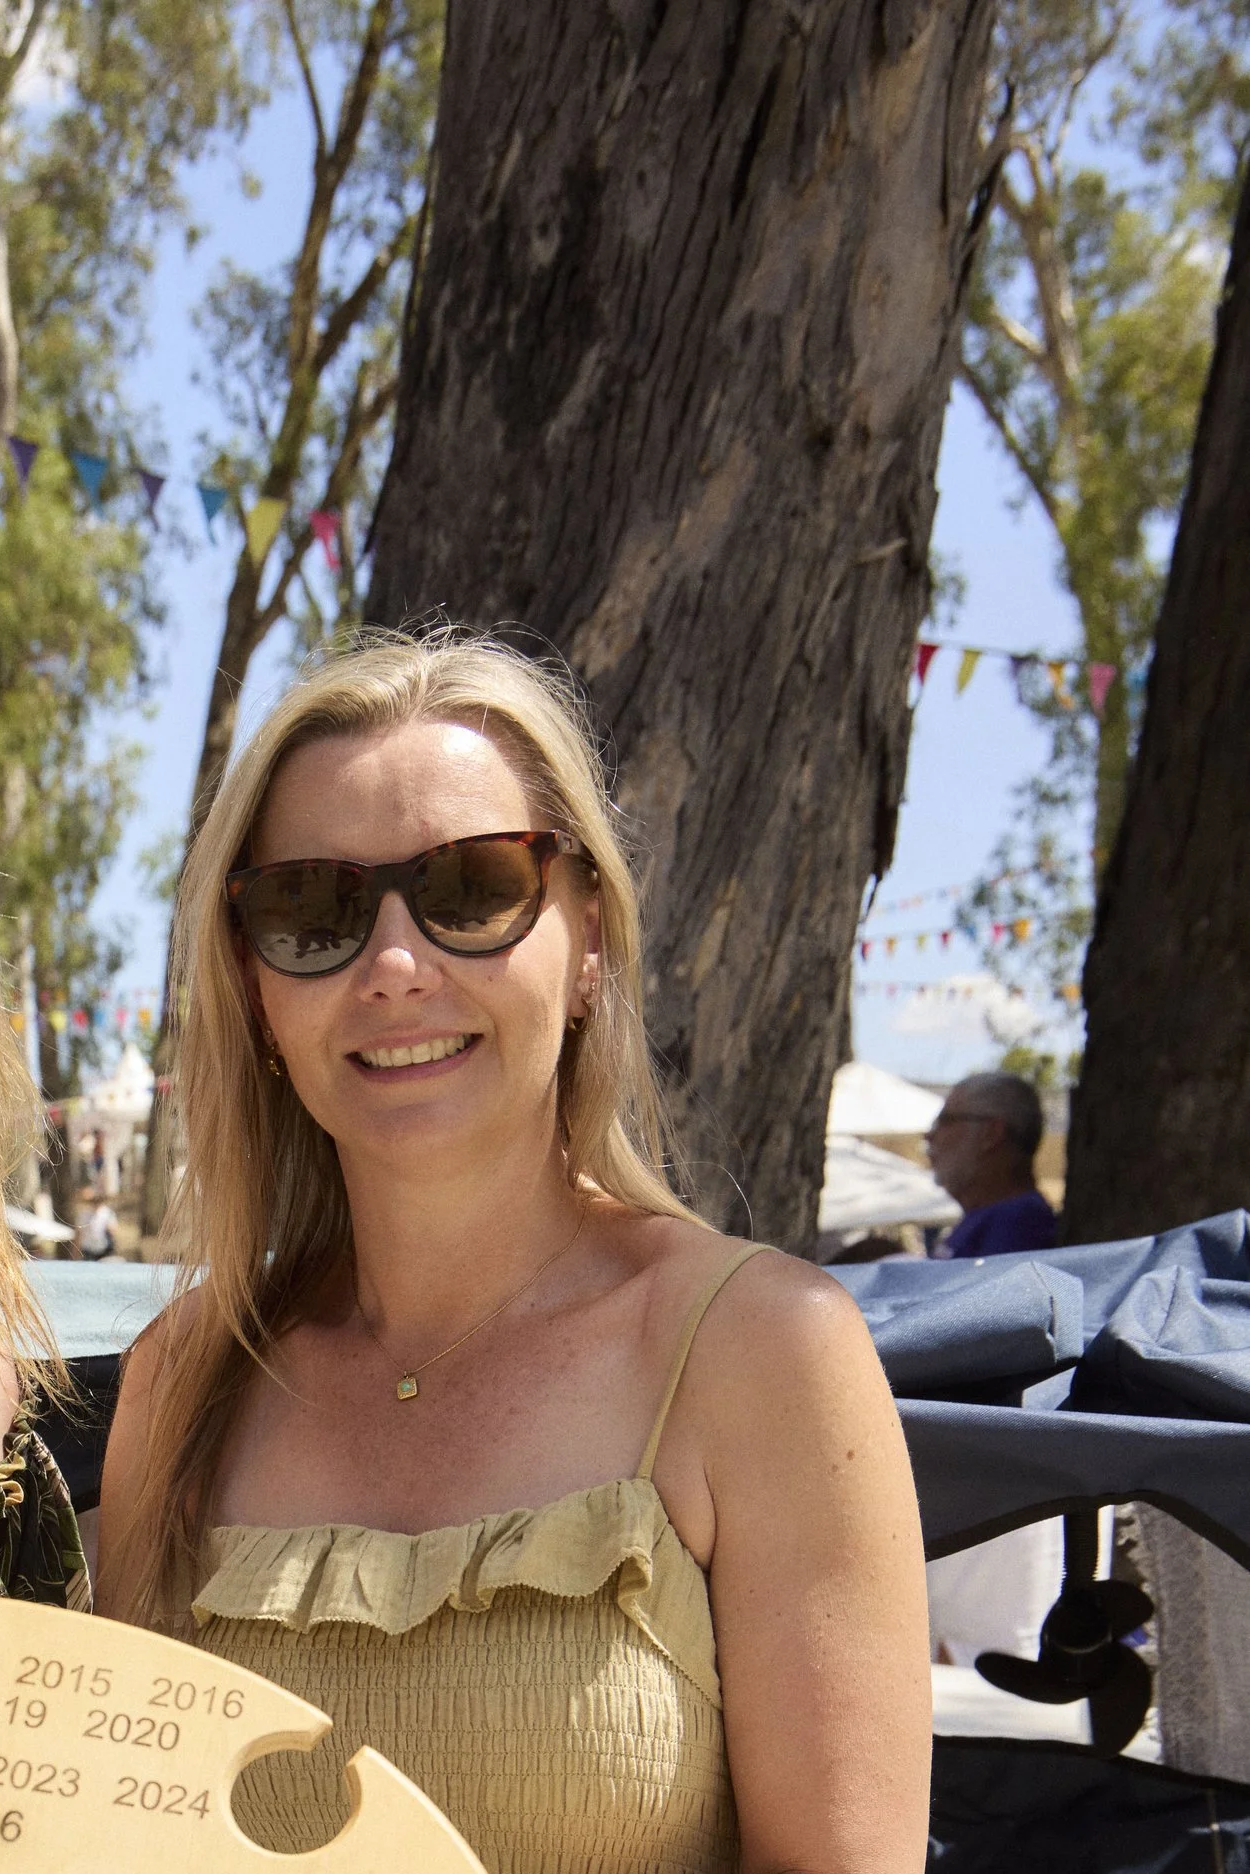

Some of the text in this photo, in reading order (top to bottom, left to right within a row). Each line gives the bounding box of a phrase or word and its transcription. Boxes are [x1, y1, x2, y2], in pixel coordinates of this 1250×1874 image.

[15, 1655, 114, 1697] 2015
[148, 1677, 245, 1719] 2016
[83, 1709, 181, 1752] 2020
[112, 1776, 210, 1820] 2024
